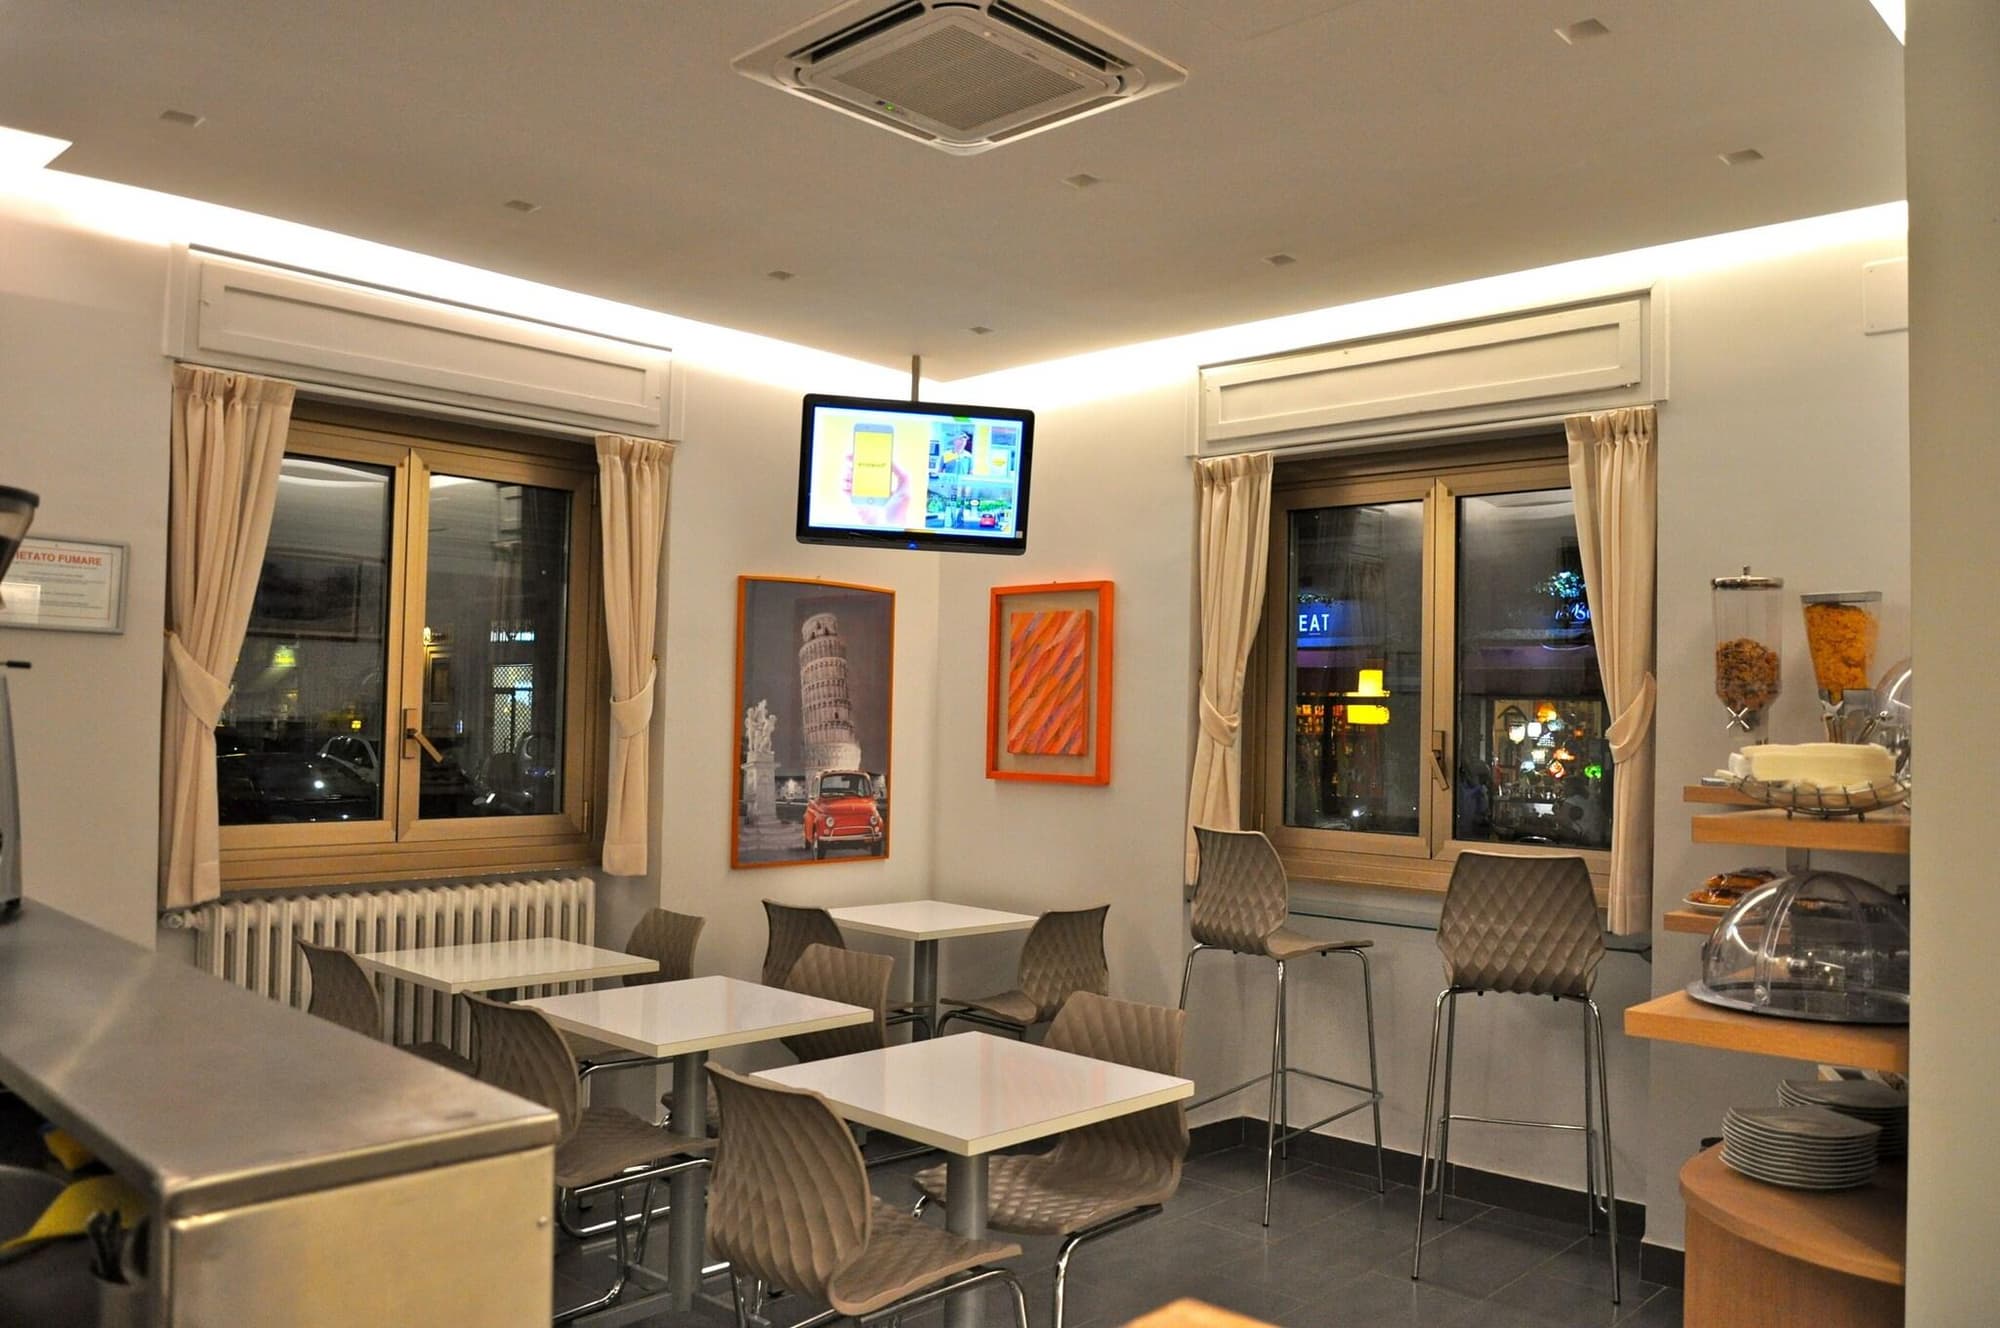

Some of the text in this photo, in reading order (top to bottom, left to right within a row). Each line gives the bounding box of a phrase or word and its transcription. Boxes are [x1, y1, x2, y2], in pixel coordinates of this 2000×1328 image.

[15, 551, 55, 562] IETATO
[58, 554, 102, 566] FUMARE
[1299, 614, 1330, 632] EAT
